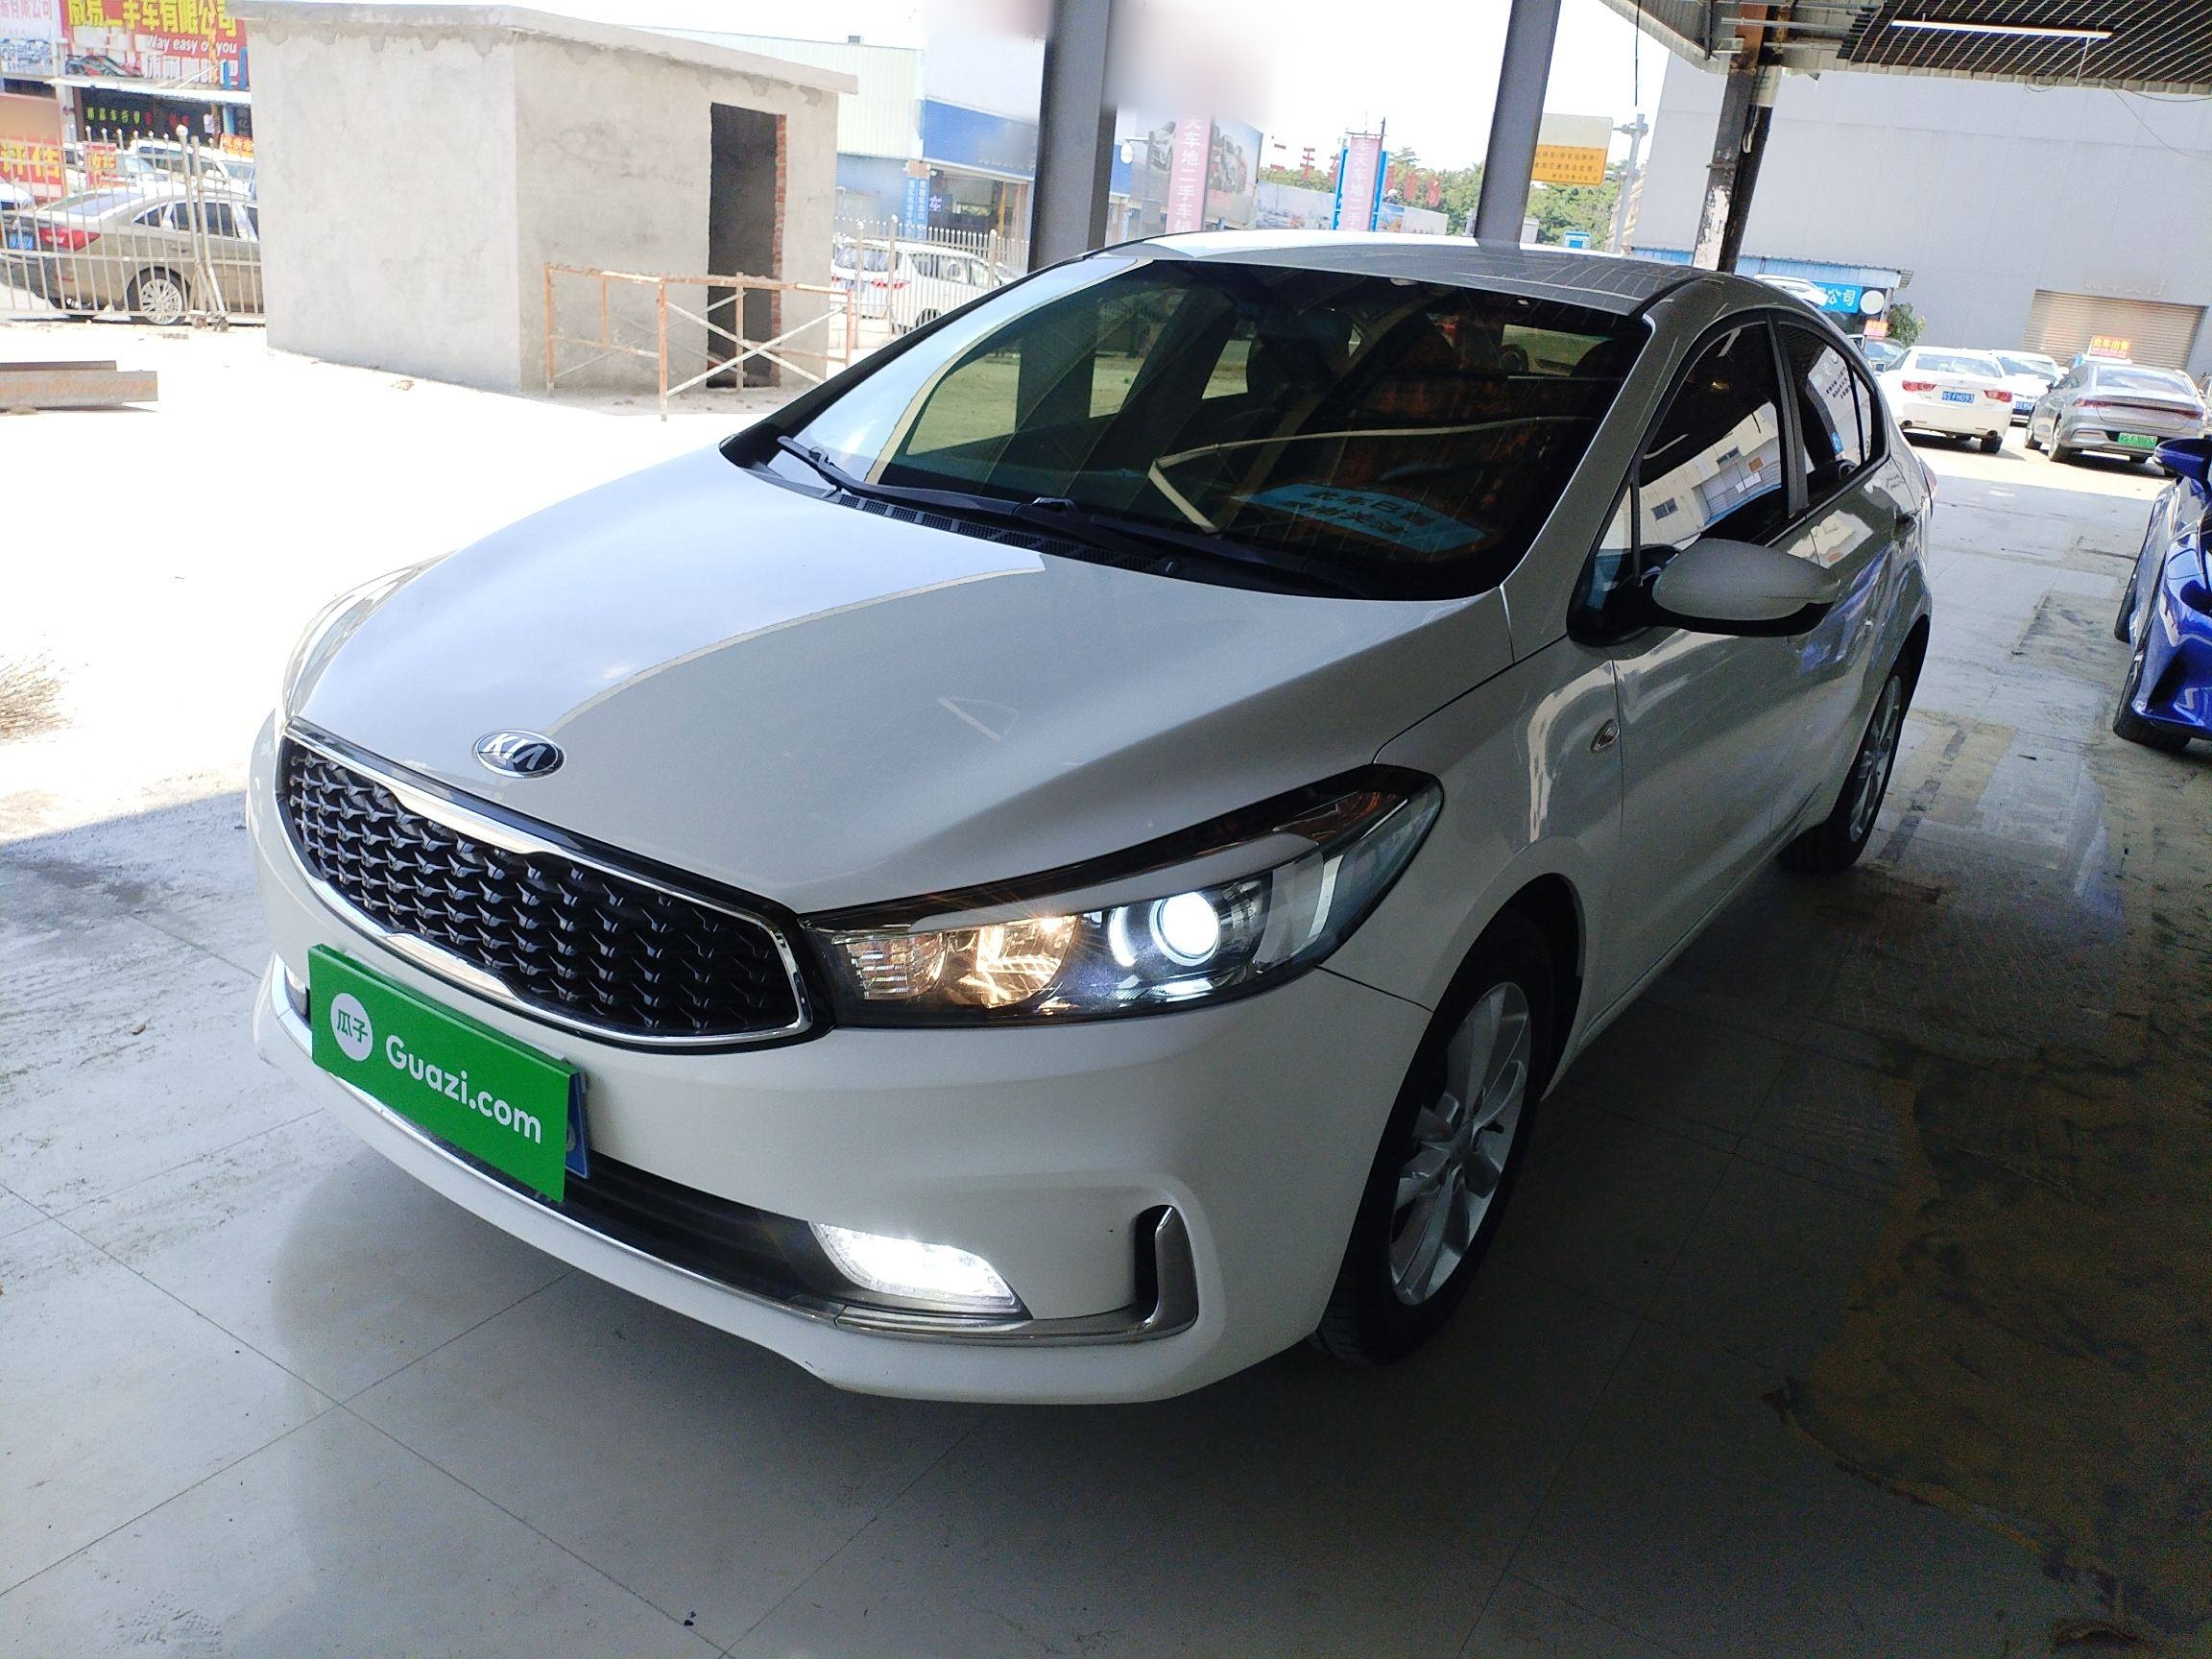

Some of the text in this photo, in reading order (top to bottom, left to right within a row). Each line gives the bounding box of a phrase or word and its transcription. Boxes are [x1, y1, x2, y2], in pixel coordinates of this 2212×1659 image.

[173, 40, 198, 56] easy
[216, 42, 238, 56] you
[1827, 289, 1856, 307] 公司
[481, 733, 548, 771] KIA
[336, 1008, 369, 1044] 瓜子
[385, 1034, 542, 1144] Guazi.com
